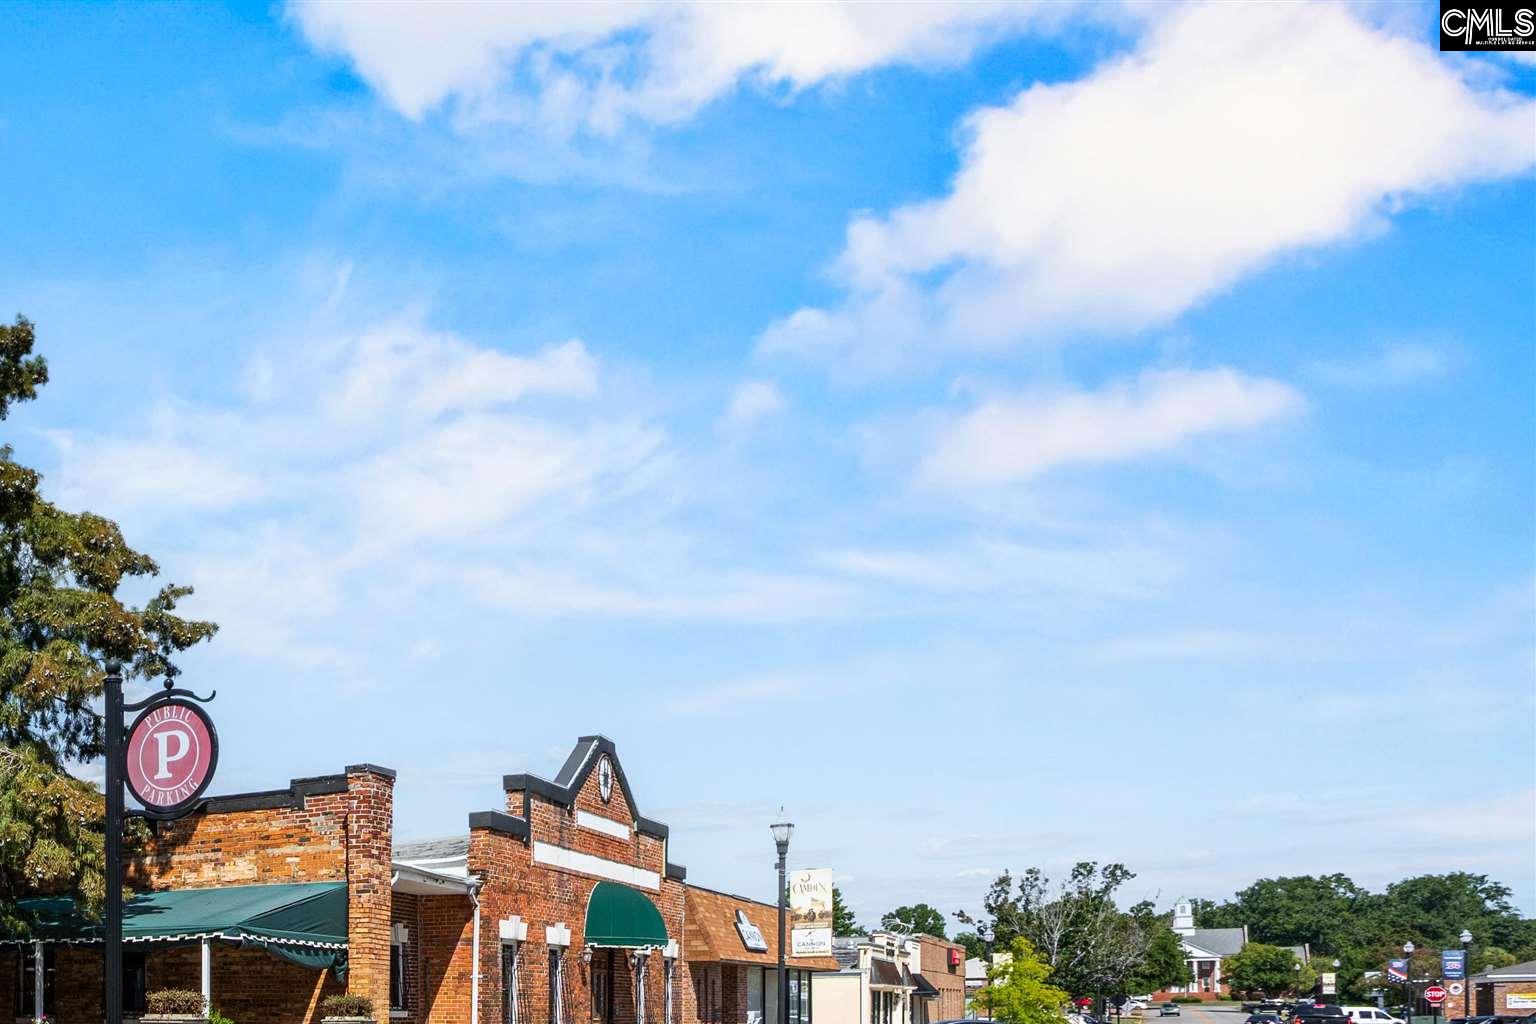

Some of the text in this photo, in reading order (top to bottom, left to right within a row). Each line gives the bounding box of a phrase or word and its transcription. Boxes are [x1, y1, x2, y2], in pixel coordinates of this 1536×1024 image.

[144, 705, 194, 728] PUBLIC
[154, 730, 190, 780] P
[141, 778, 199, 805] PARKING
